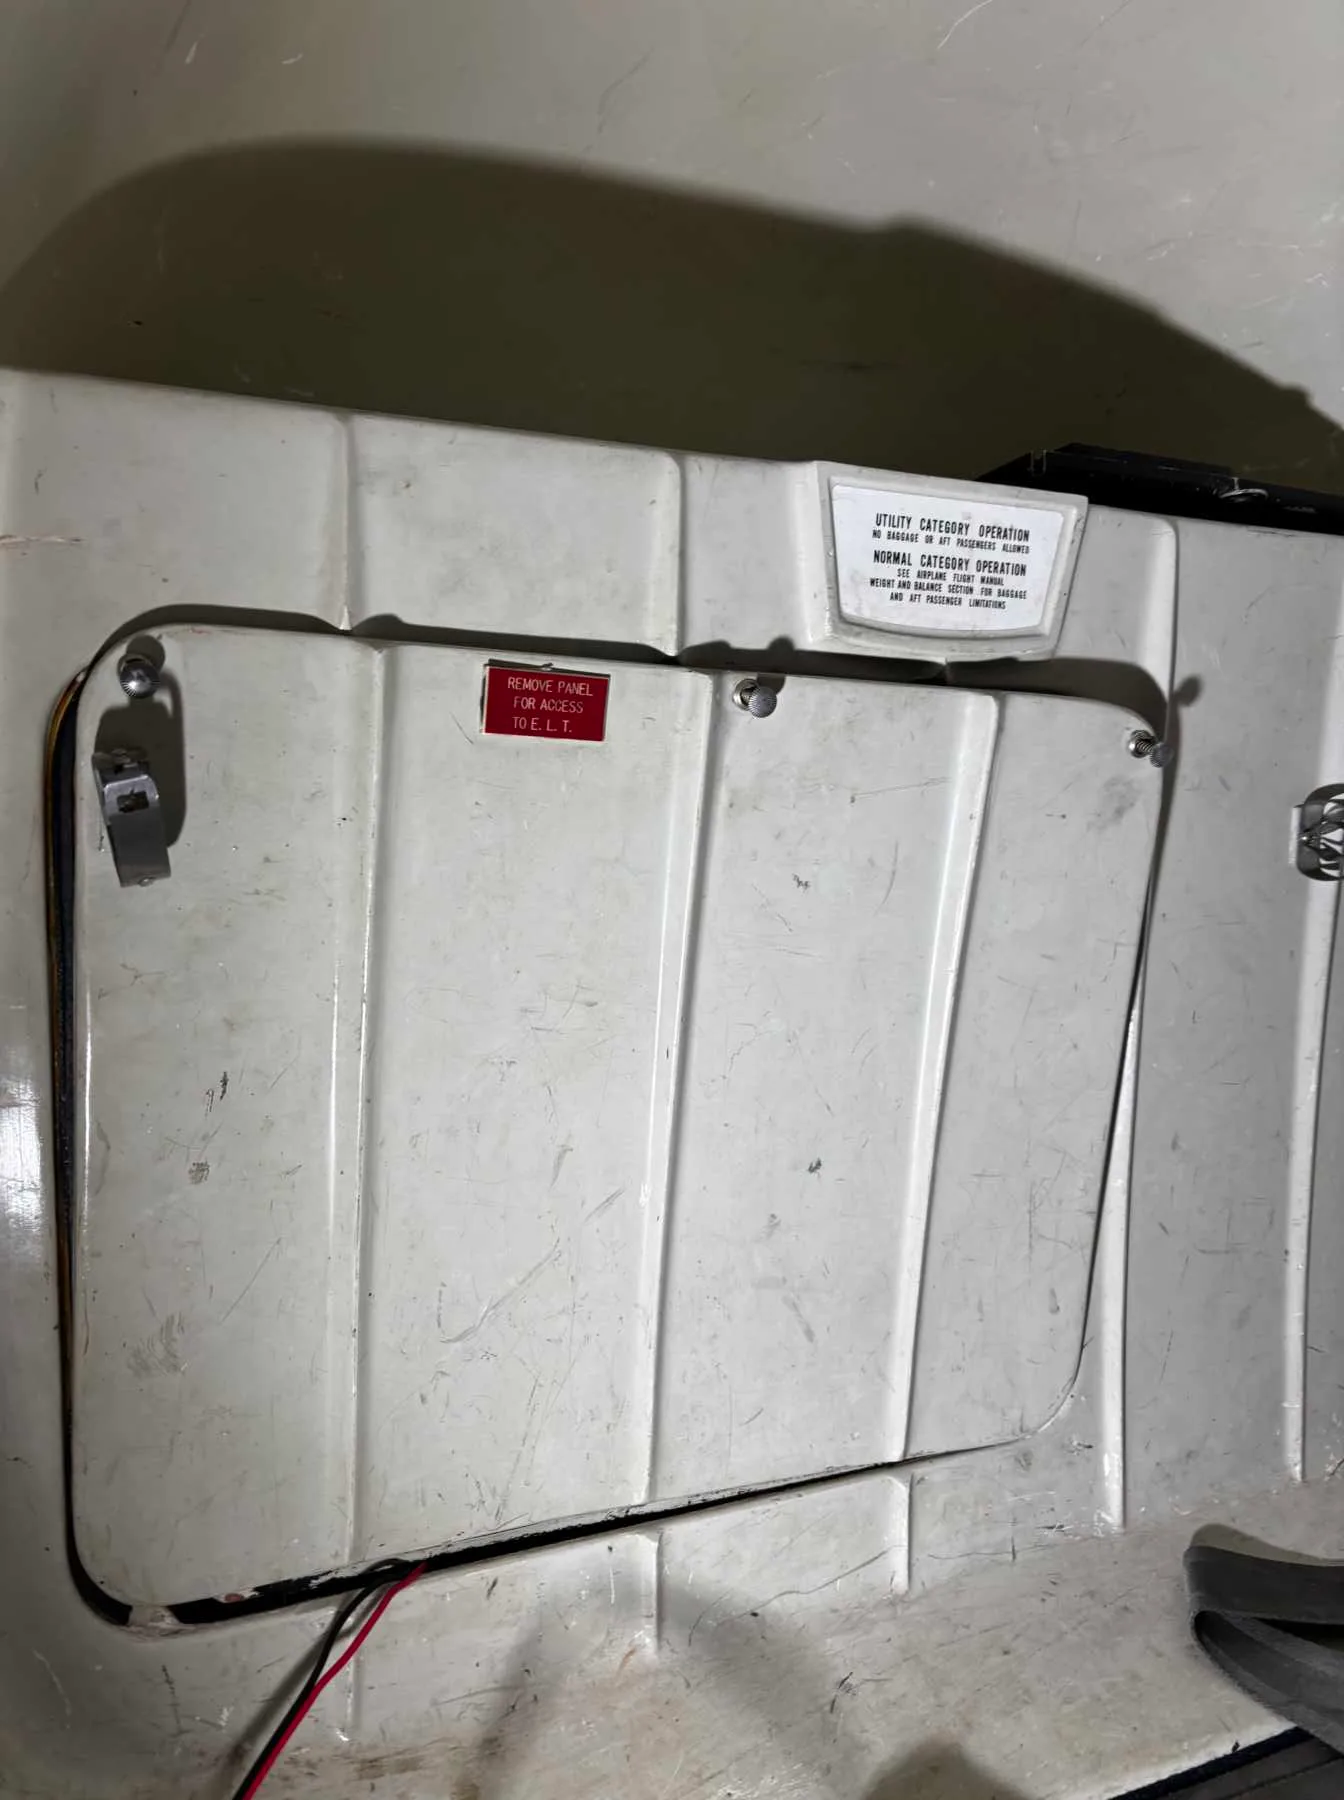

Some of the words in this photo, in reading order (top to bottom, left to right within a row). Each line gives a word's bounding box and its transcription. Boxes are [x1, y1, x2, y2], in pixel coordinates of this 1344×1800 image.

[876, 513, 912, 529] UTILITY
[920, 518, 970, 535] CATEGORY
[979, 525, 1030, 542] OPERATION
[872, 529, 881, 539] NO
[887, 531, 919, 542] BAGGAGE
[925, 535, 933, 544] OR
[939, 536, 951, 545] AFT
[956, 538, 996, 551] PASSENGERS
[1002, 543, 1029, 554] ALLOWED
[873, 550, 912, 566] NORMAL
[920, 554, 970, 571] CATEGORY
[976, 560, 1027, 576] OPERATION
[897, 568, 910, 578] SEE
[917, 570, 946, 581] AIRPLANE
[953, 573, 975, 583] FLIGHT
[980, 576, 1004, 586] MANUAL
[870, 578, 895, 588] WEIGHT
[897, 580, 911, 589] AND
[914, 581, 943, 592] BALANCE
[948, 584, 974, 594] SECTION
[980, 587, 992, 596] FOR
[997, 588, 1027, 599] BAGGAGE
[890, 592, 903, 601] AND
[909, 594, 921, 602] AFT
[926, 595, 962, 606] PASSENGER
[969, 599, 1006, 609] LIMITATIONS
[508, 677, 553, 693] REMOVE
[558, 681, 593, 696] PANEL
[513, 696, 536, 710] FOR
[540, 698, 583, 714] ACCESS
[512, 716, 527, 729] TO
